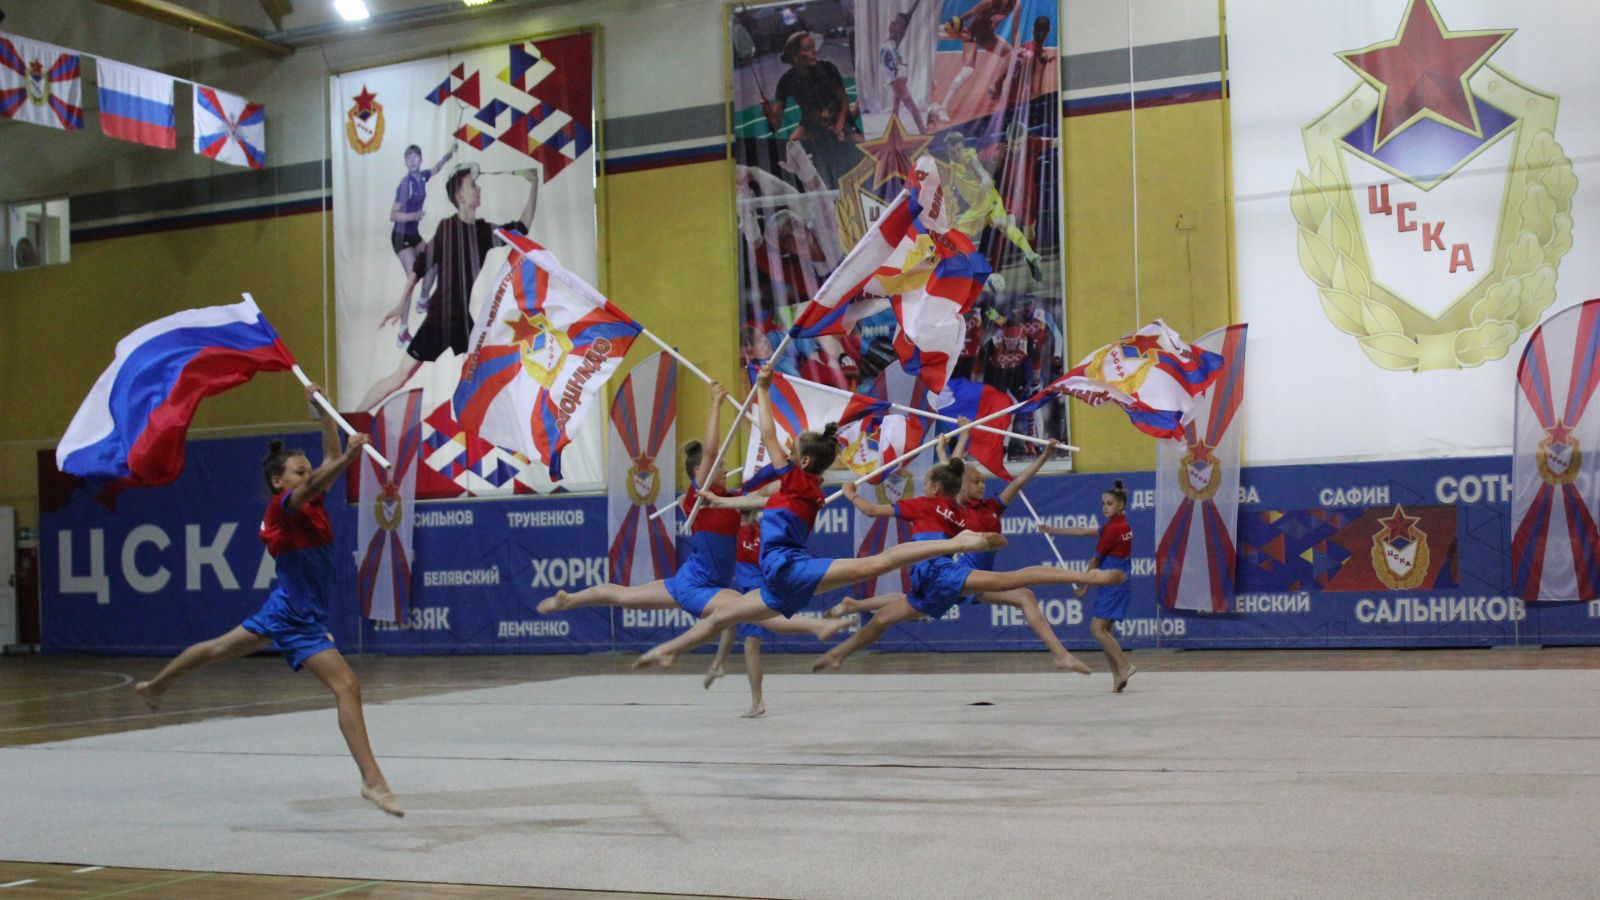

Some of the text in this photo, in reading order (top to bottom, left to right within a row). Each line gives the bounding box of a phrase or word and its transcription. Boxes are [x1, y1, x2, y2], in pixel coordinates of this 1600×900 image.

[1367, 183, 1475, 274] ЦСКА
[1319, 486, 1391, 506] САФИН
[1435, 475, 1513, 504] СОТН
[414, 509, 474, 527] СИЛЬНОВ
[507, 510, 584, 528] ТРУНЕНКОВ
[1387, 550, 1412, 567] ЦСКА
[423, 566, 500, 587] БЕЛЯВСКИЙ
[1235, 591, 1310, 612] ЕНСКИЙ
[1355, 596, 1526, 623] САЛЬНИКОВ
[497, 621, 569, 638] ДЕМЧЕНКО
[1115, 618, 1186, 636] ЧУПКОВ
